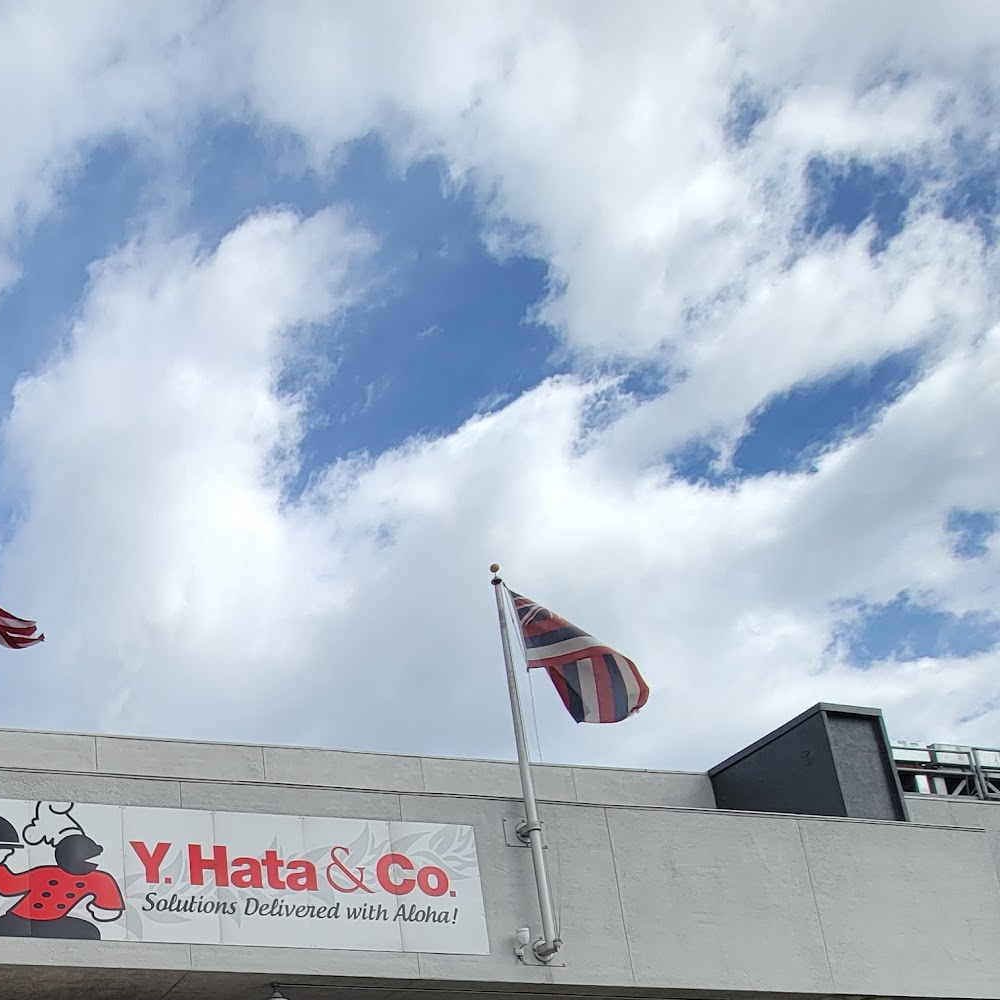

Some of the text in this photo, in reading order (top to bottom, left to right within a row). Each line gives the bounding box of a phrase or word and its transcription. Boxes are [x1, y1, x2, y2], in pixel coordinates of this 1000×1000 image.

[130, 841, 457, 898] Y. Hata & Co.
[141, 892, 459, 925] Solutions Delivered with Aloha!
